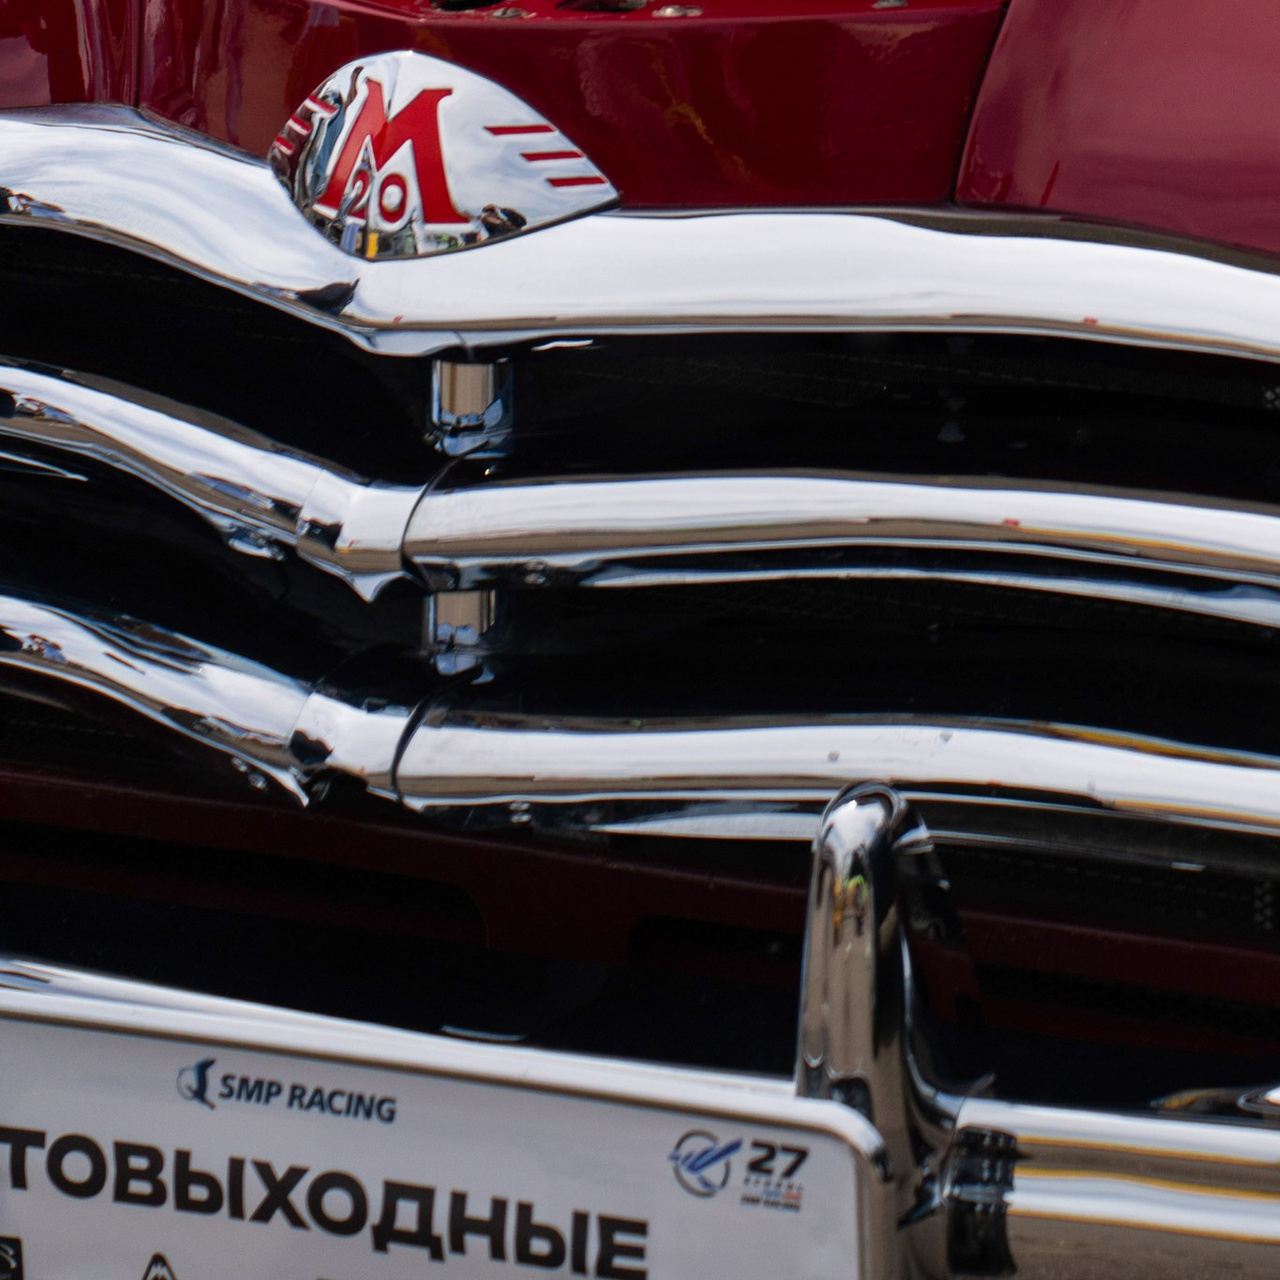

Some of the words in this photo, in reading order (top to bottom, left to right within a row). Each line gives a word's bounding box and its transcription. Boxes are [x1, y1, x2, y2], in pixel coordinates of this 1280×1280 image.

[219, 1073, 283, 1106] SMP
[287, 1083, 397, 1124] RACING
[747, 1139, 810, 1179] 27
[0, 1126, 648, 1280] ТОВЫХОДНЫЕ
